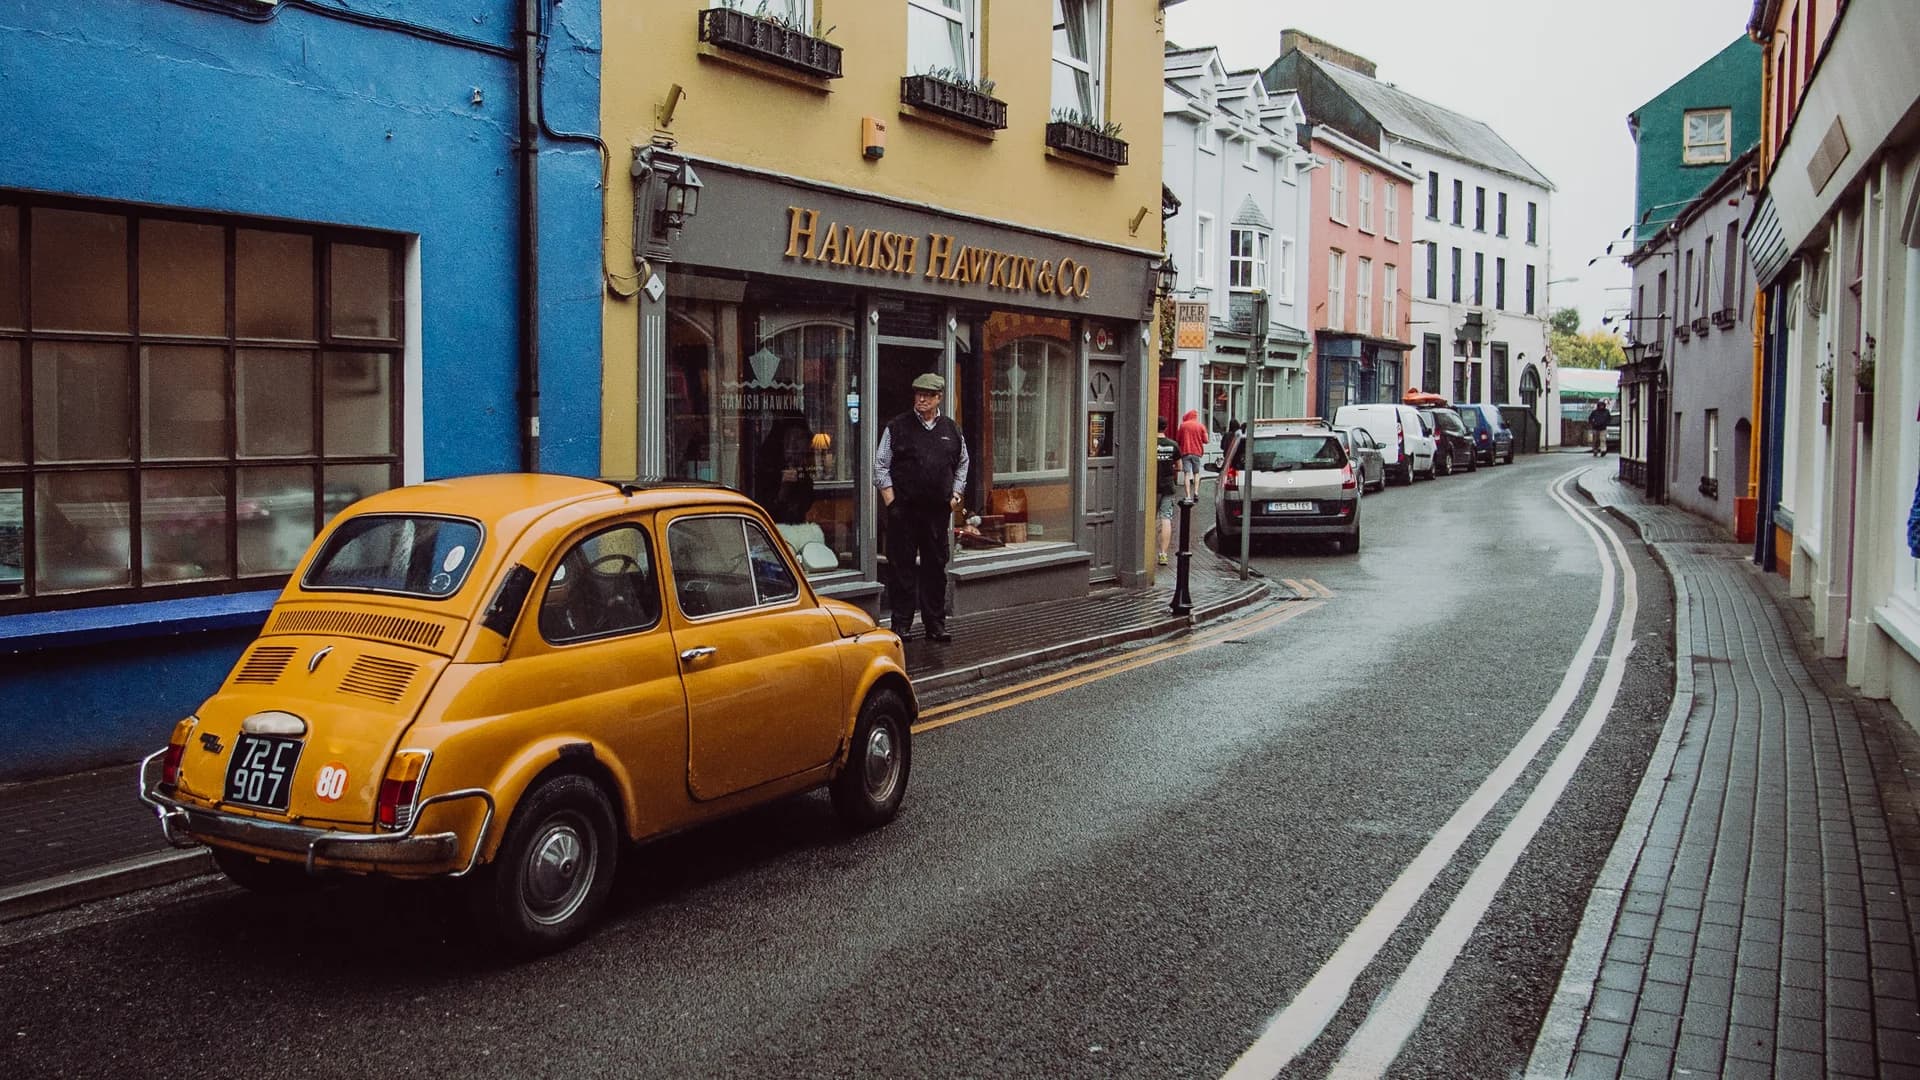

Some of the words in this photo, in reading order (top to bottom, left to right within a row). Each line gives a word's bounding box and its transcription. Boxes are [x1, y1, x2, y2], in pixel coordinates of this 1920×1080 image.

[785, 206, 920, 274] HAMISH
[1179, 305, 1205, 316] PIER
[720, 394, 759, 410] HAMISH
[232, 768, 283, 805] 907
[316, 766, 348, 800] 80
